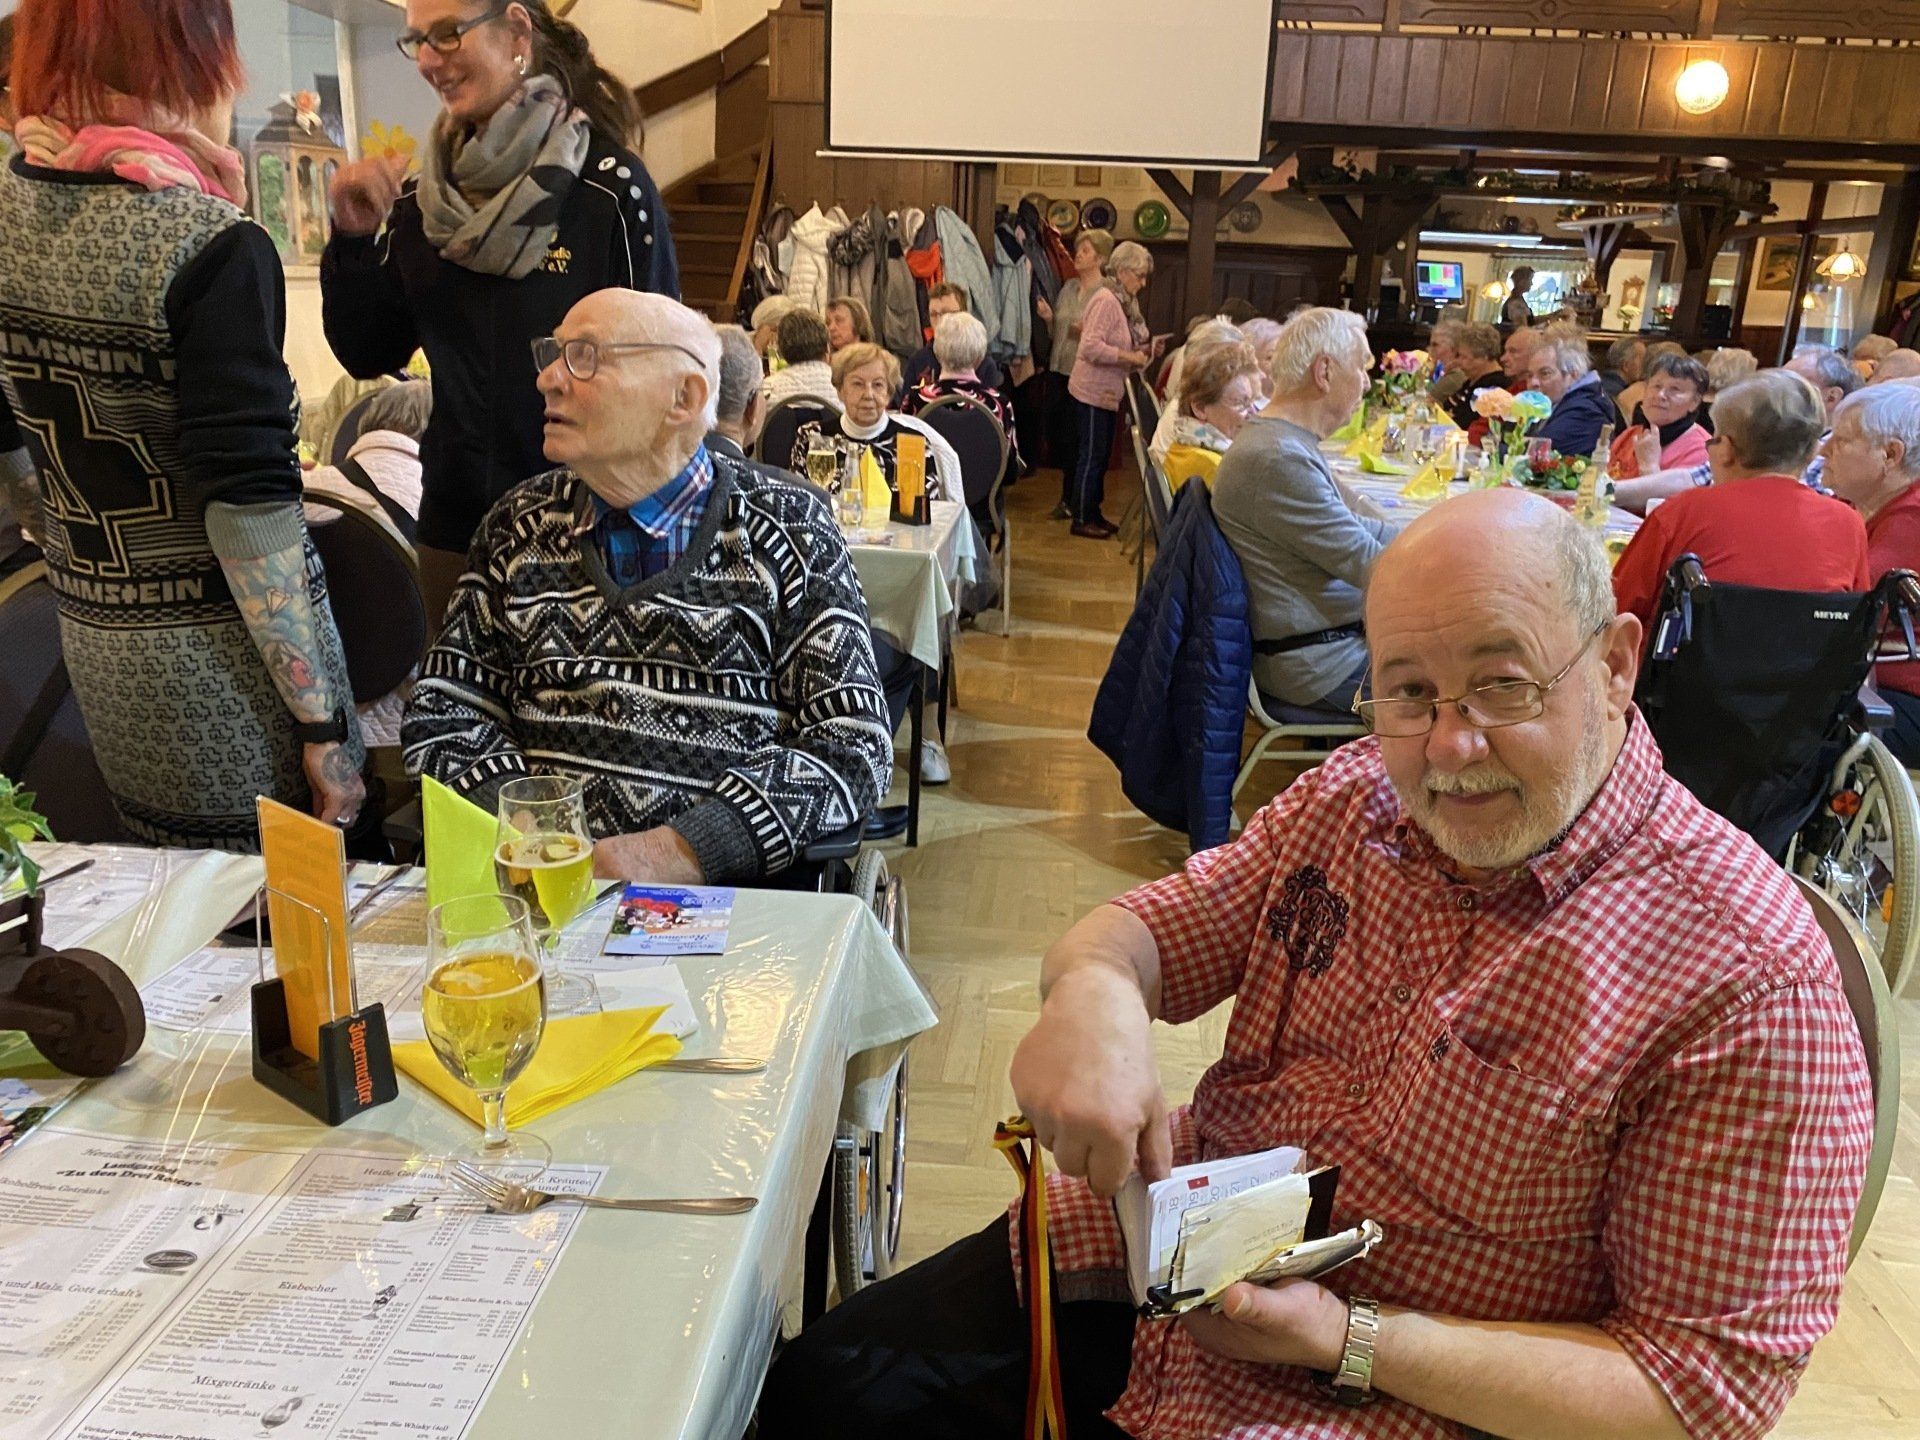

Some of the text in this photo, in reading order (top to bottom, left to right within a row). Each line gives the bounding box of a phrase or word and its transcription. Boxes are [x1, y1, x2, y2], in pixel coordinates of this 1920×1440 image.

[1814, 610, 1849, 621] MEYRA
[90, 1169, 117, 1177] den
[118, 1171, 152, 1180] Drei
[538, 1185, 559, 1193] und
[1168, 1196, 1180, 1214] 18
[1188, 1191, 1199, 1207] 19
[6, 1280, 31, 1289] und
[68, 1284, 96, 1294] Gott
[278, 1281, 337, 1293] Eisbecher
[191, 1375, 275, 1390] Mixgetränke
